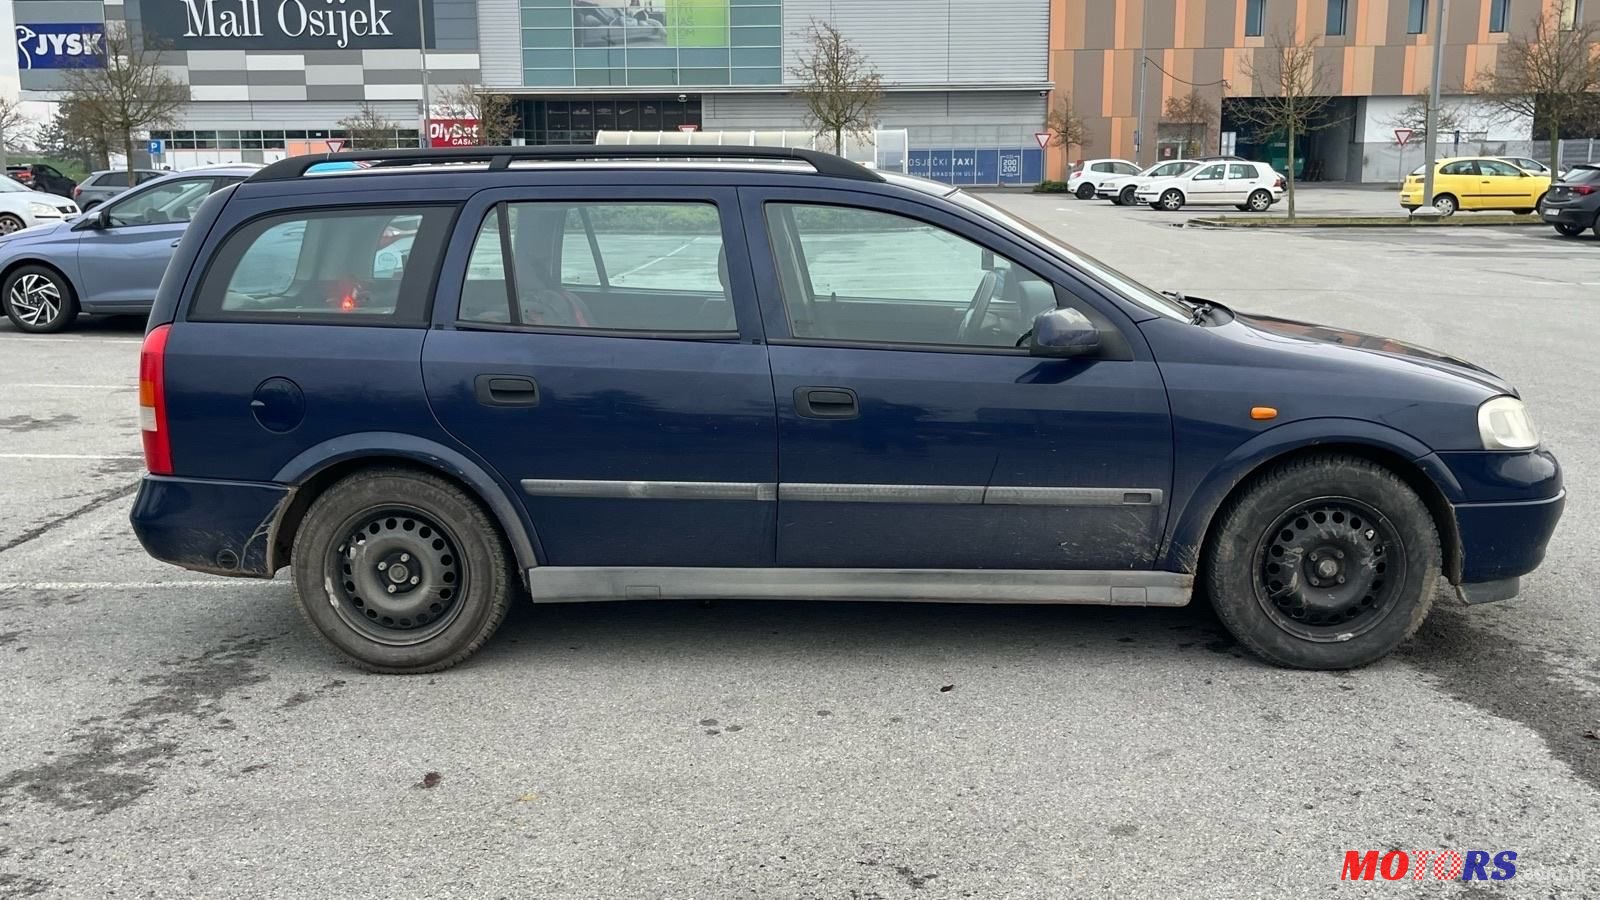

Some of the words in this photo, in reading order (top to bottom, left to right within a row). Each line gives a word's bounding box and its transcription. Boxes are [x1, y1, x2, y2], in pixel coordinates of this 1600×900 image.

[183, 0, 264, 37] Mall
[277, 0, 393, 48] Osijek
[35, 33, 103, 56] JYSK
[452, 138, 479, 146] CASI
[952, 157, 974, 166] TAXI
[1003, 165, 1017, 173] 200
